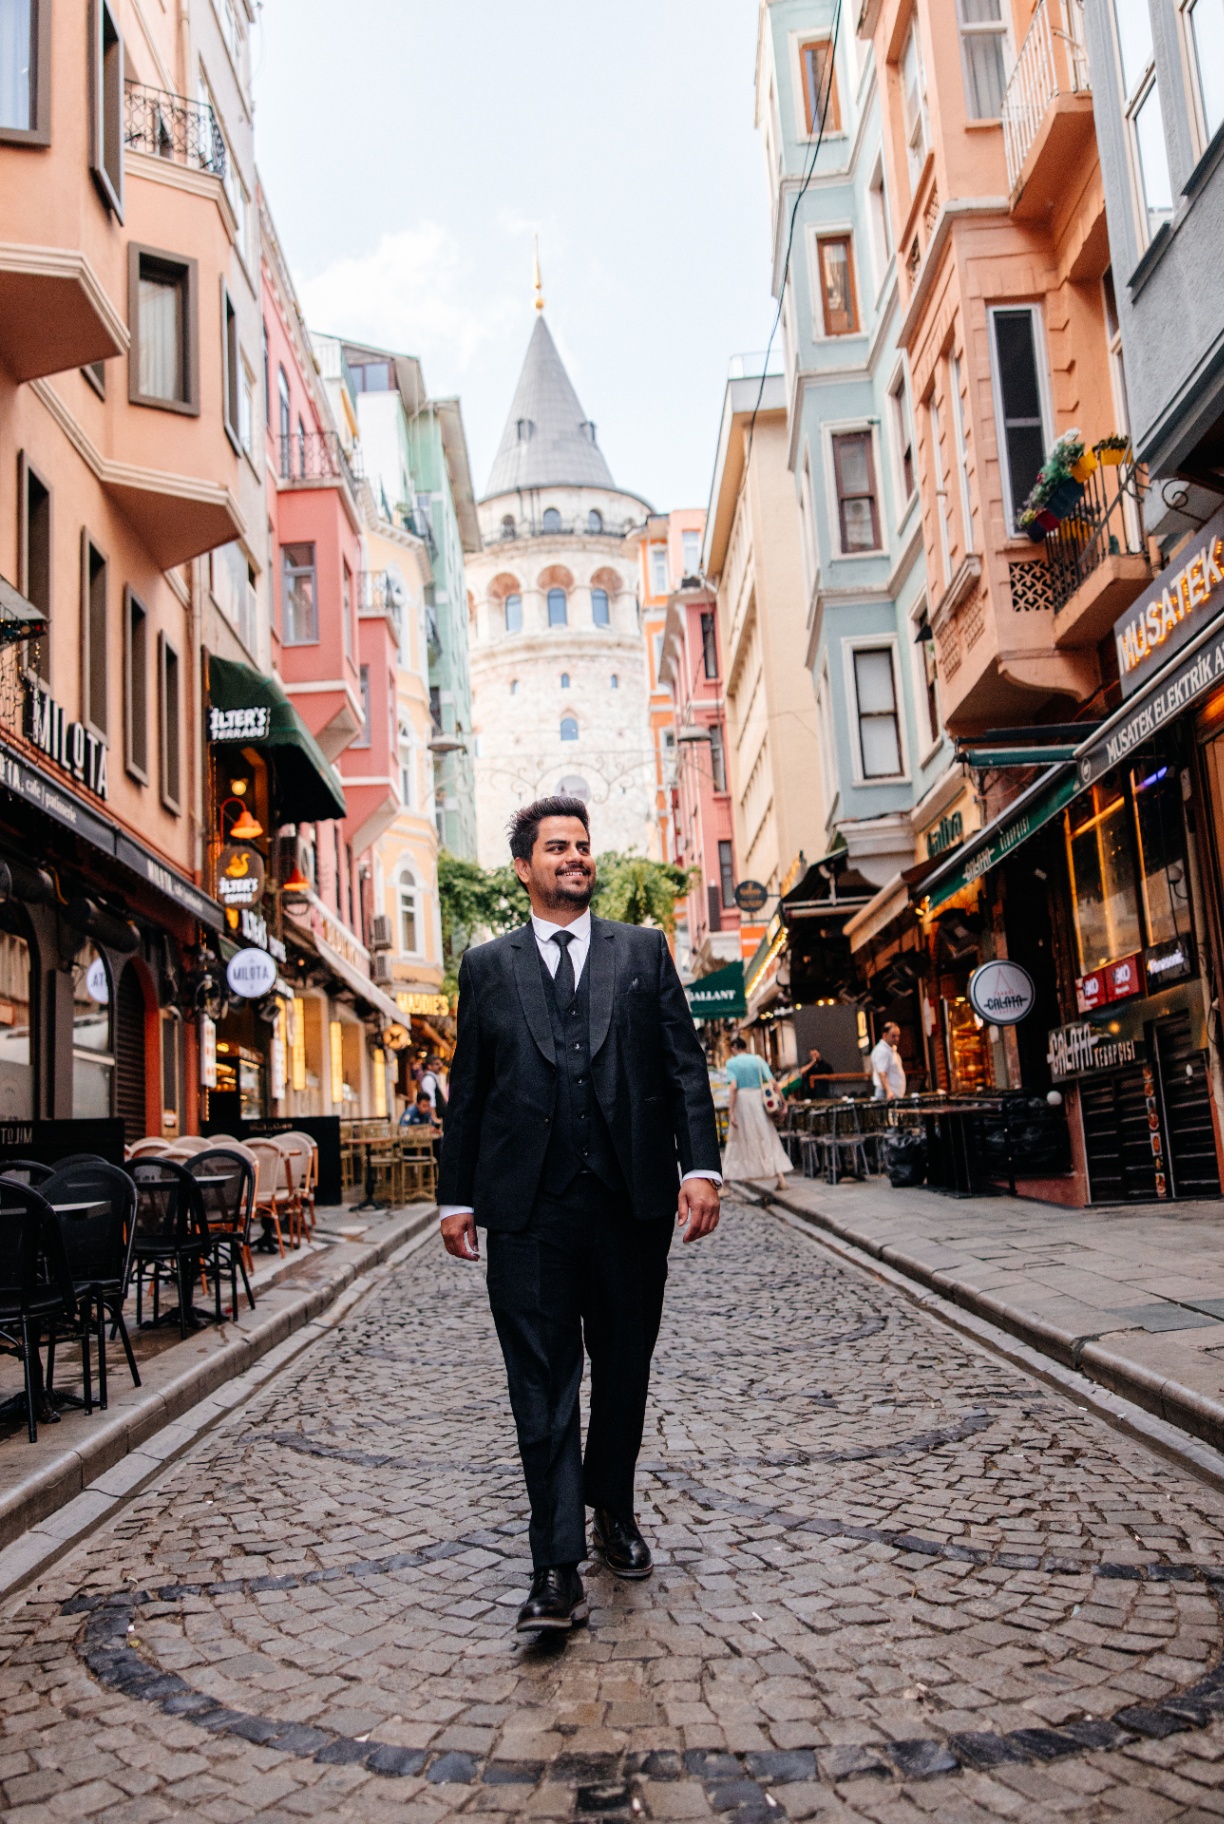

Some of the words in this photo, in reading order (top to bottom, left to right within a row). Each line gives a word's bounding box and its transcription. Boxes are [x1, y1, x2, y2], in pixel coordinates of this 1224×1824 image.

[1116, 535, 1223, 676] MUSATEK
[32, 687, 109, 801] MILOTA
[1105, 705, 1155, 764] MUSATEK
[1153, 653, 1213, 725] ELEKTRİK
[233, 966, 270, 981] MILOTA
